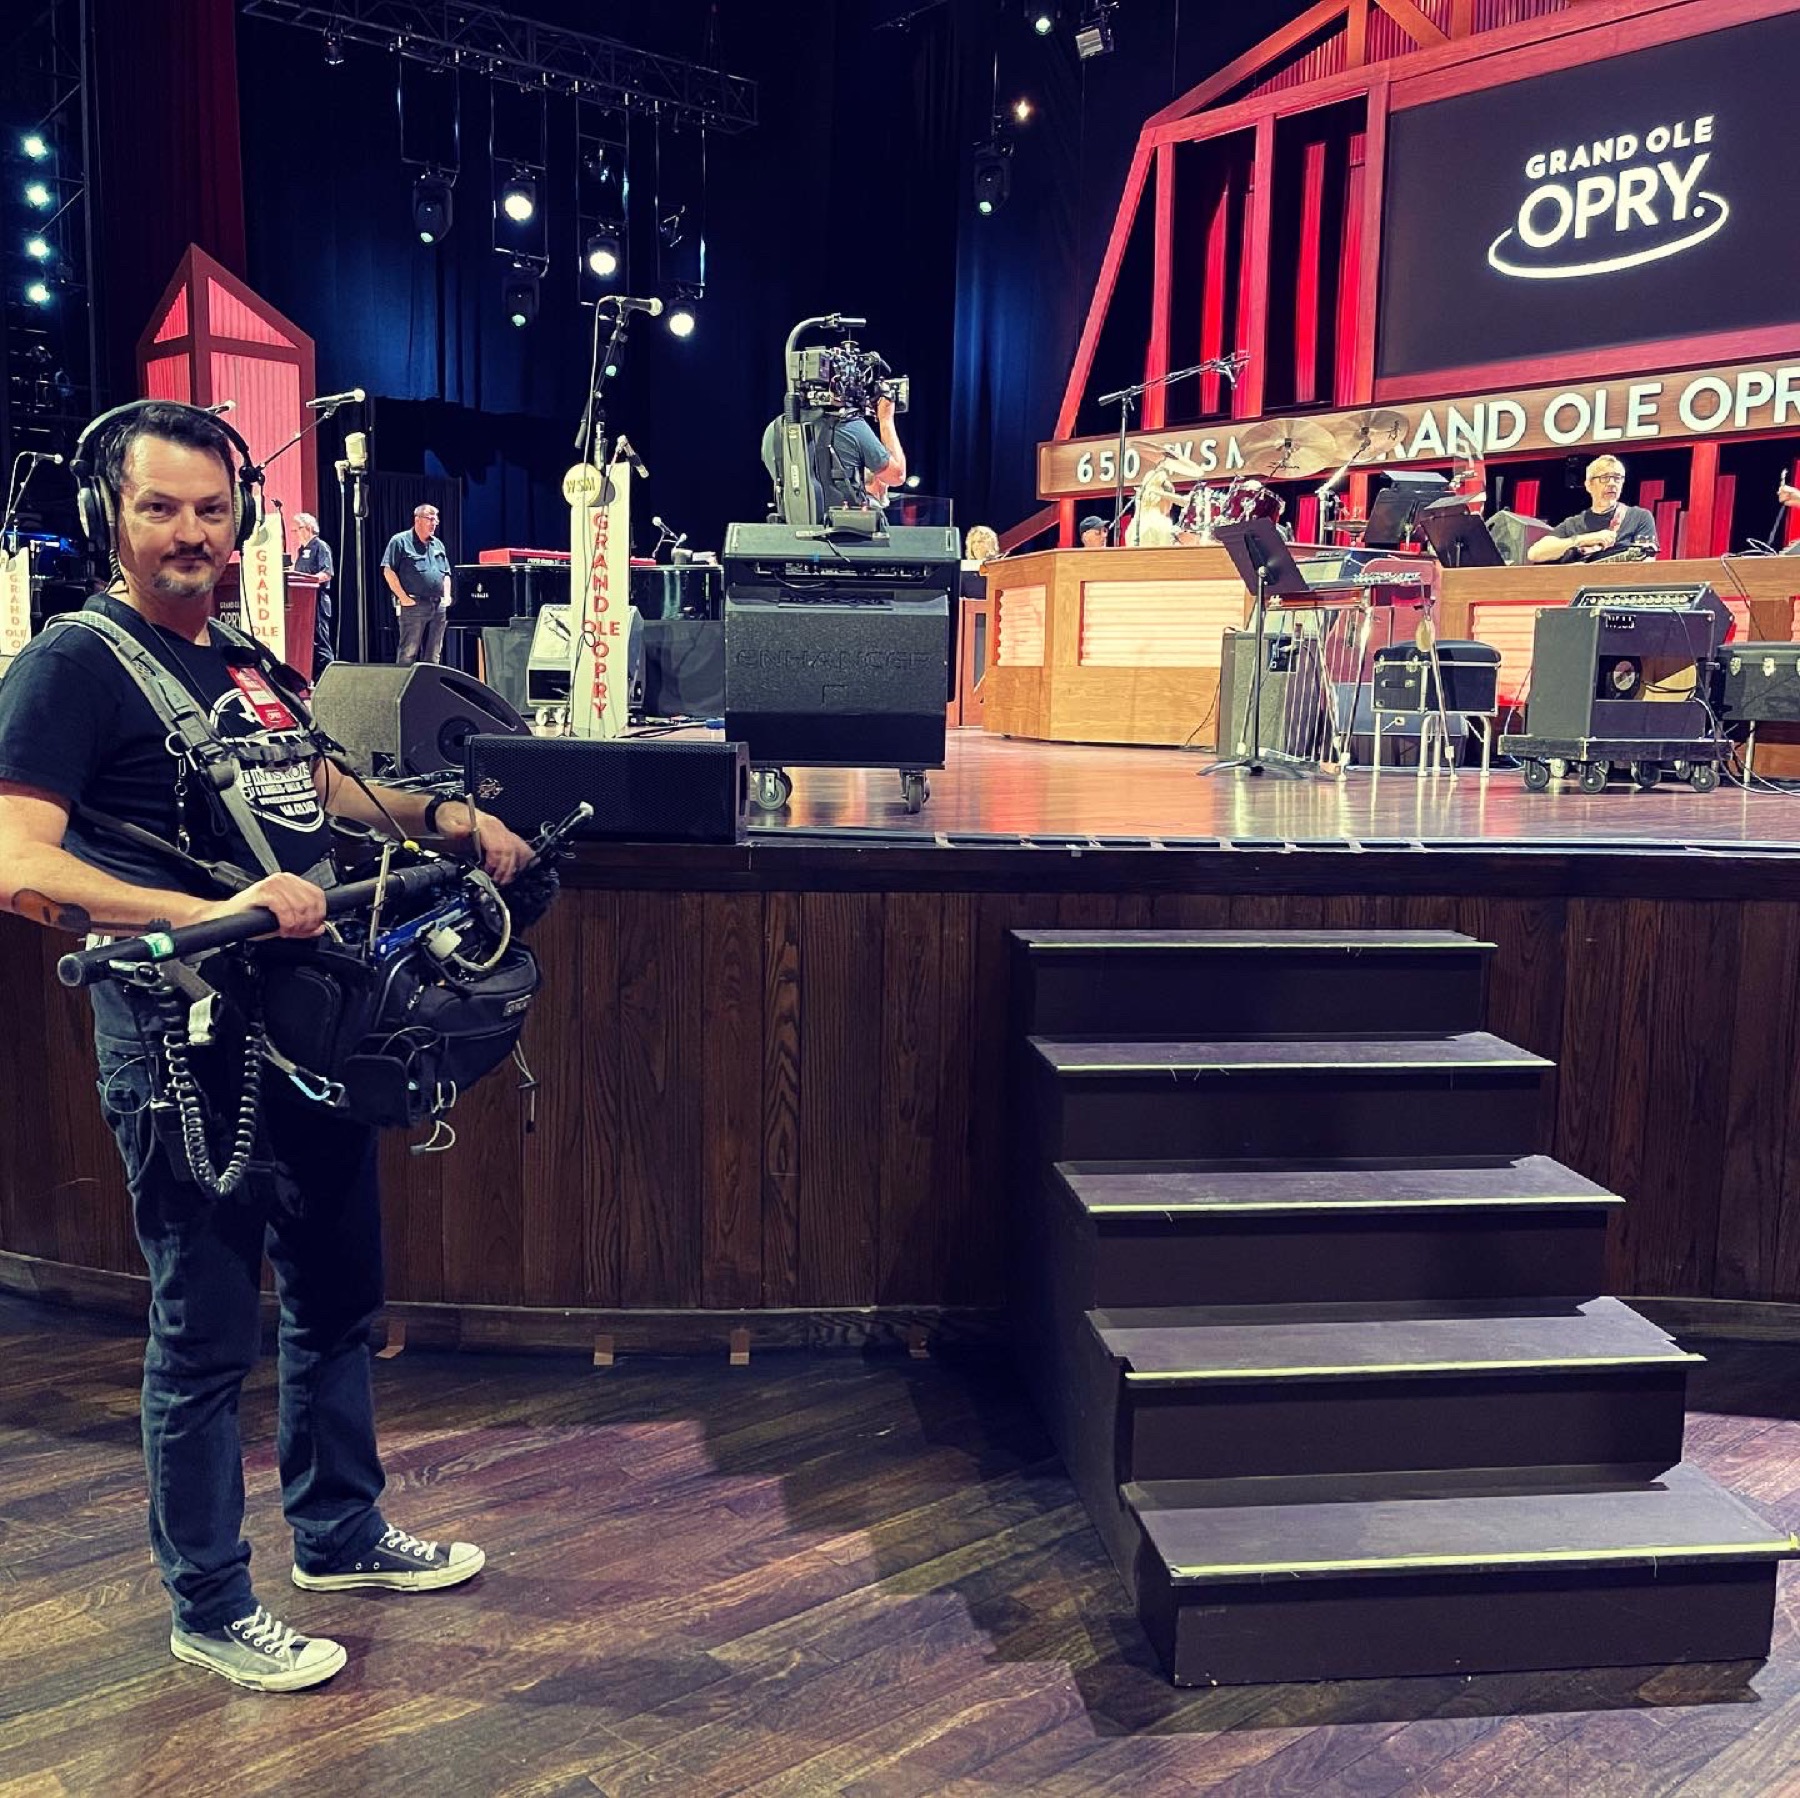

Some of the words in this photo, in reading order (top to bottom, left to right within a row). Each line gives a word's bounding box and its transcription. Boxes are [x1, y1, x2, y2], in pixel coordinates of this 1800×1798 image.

[1525, 134, 1639, 179] GRAND
[1645, 115, 1714, 154] OLE
[1076, 449, 1141, 483] 650
[1543, 382, 1662, 445] OLE
[255, 549, 270, 621] GRAND
[592, 512, 610, 614] GRAND
[10, 574, 21, 626] GRAND
[581, 619, 620, 637] OLE
[591, 640, 609, 720] OPRY
